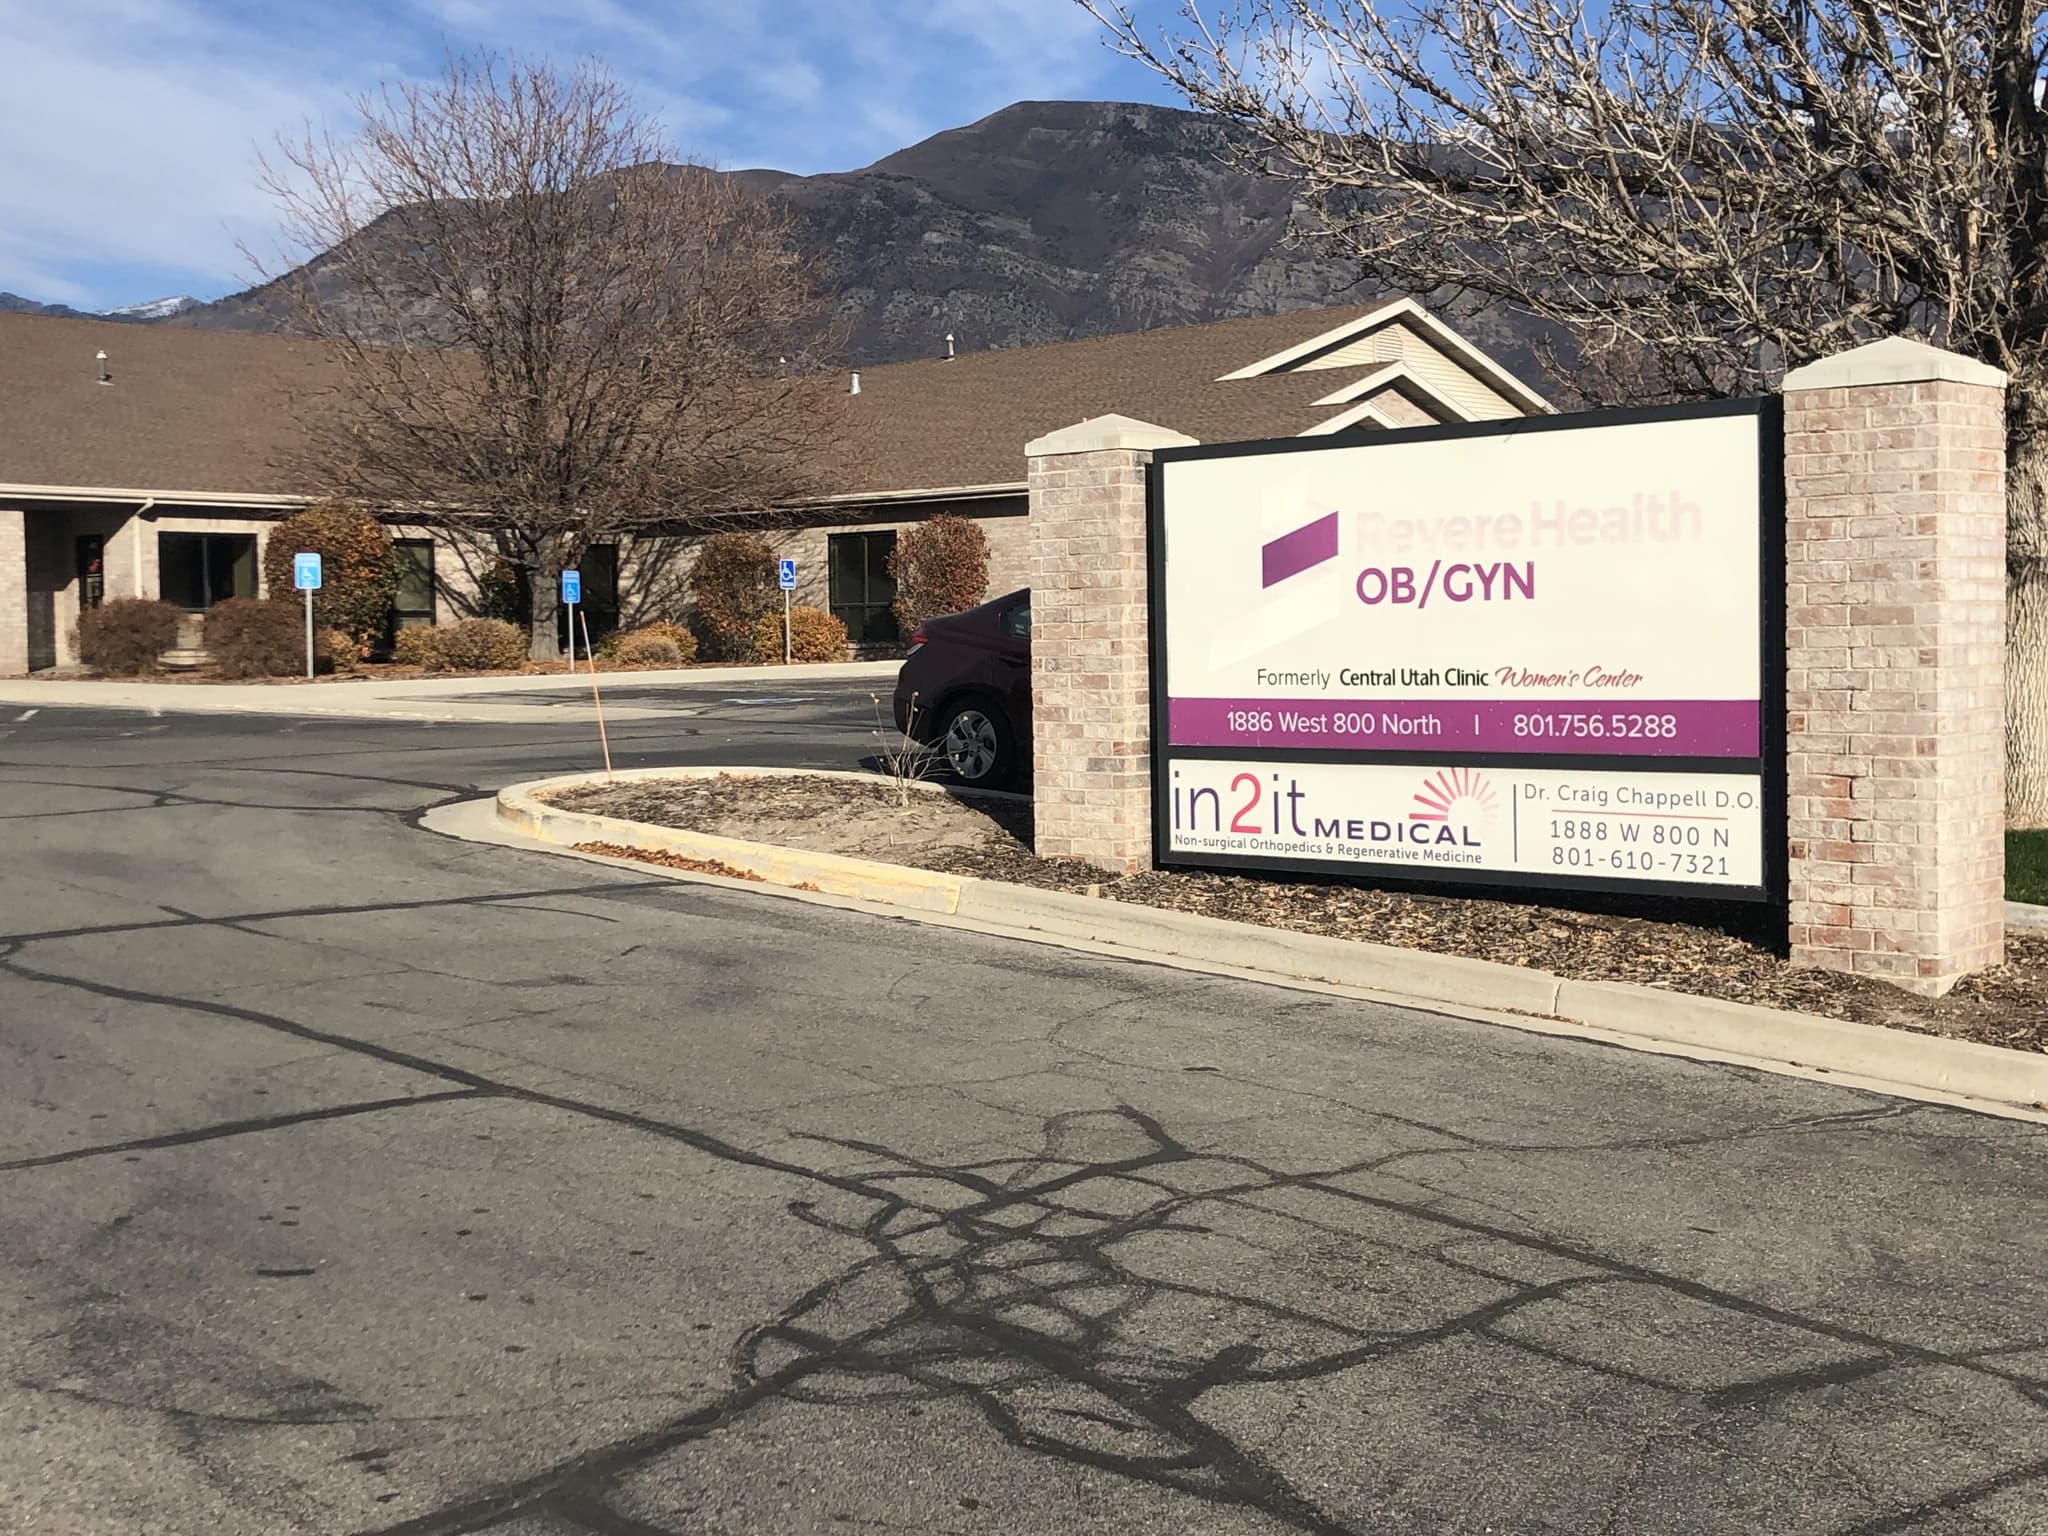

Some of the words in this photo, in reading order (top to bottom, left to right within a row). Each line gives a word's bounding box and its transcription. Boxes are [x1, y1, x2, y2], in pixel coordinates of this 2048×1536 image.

[1530, 490, 1702, 547] Health
[1356, 560, 1535, 608] OB/GYN
[1257, 668, 1331, 690] Formerly
[1340, 668, 1396, 687] Central
[1400, 668, 1440, 687] Utah
[1445, 667, 1489, 687] Clinic
[1494, 666, 1580, 689] Women's
[1582, 665, 1644, 689] Center
[1227, 711, 1273, 732] 1886
[1278, 712, 1328, 734] West
[1333, 712, 1376, 735] 800
[1382, 713, 1441, 735] North
[1513, 714, 1677, 738] 801.756.5288
[1174, 771, 1307, 837] in2it
[1314, 818, 1482, 847] MEDICAL
[1524, 783, 1550, 800] Dr.
[1557, 784, 1608, 807] Craig
[1616, 786, 1706, 810] Chappell
[1715, 791, 1759, 809] D.O.
[1551, 820, 1608, 841] 1888
[1619, 823, 1641, 843] W
[1652, 825, 1700, 846] 800
[1713, 828, 1729, 848] N
[1174, 835, 1247, 850] Non-surgical
[1250, 838, 1322, 854] Orthopedics
[1325, 843, 1334, 853] &
[1338, 844, 1419, 860] Regenerative
[1423, 849, 1482, 864] Medicine
[1552, 846, 1729, 876] 801-610-7321
